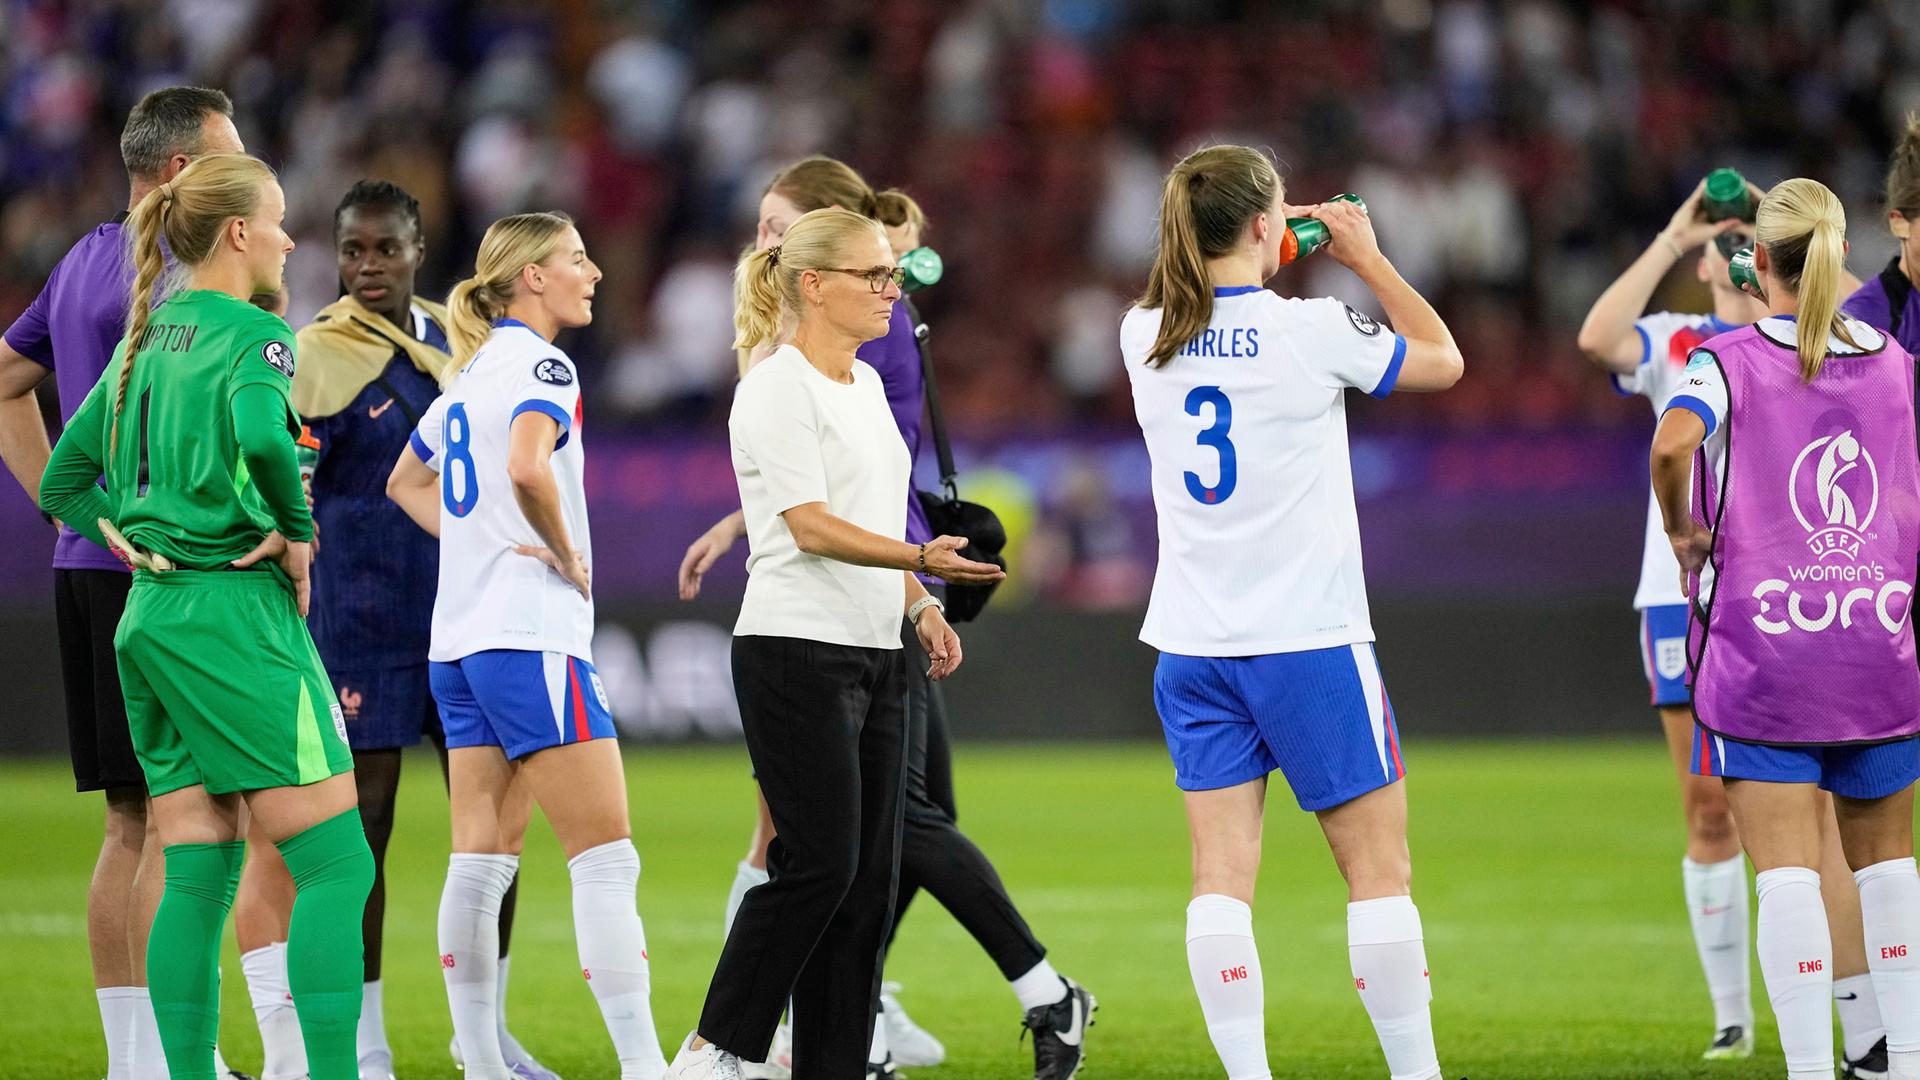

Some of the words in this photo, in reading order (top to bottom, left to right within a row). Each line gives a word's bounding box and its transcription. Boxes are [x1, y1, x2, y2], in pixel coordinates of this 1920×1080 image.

[137, 324, 198, 353] MPTON
[1180, 328, 1259, 358] ARLES
[136, 380, 152, 498] 1
[1183, 385, 1237, 505] 3
[442, 402, 480, 519] 8
[1809, 533, 1860, 557] UEFA
[1788, 560, 1885, 581] women's
[1881, 944, 1907, 959] ENG
[1220, 965, 1248, 983] ENG
[1798, 960, 1823, 974] ENG
